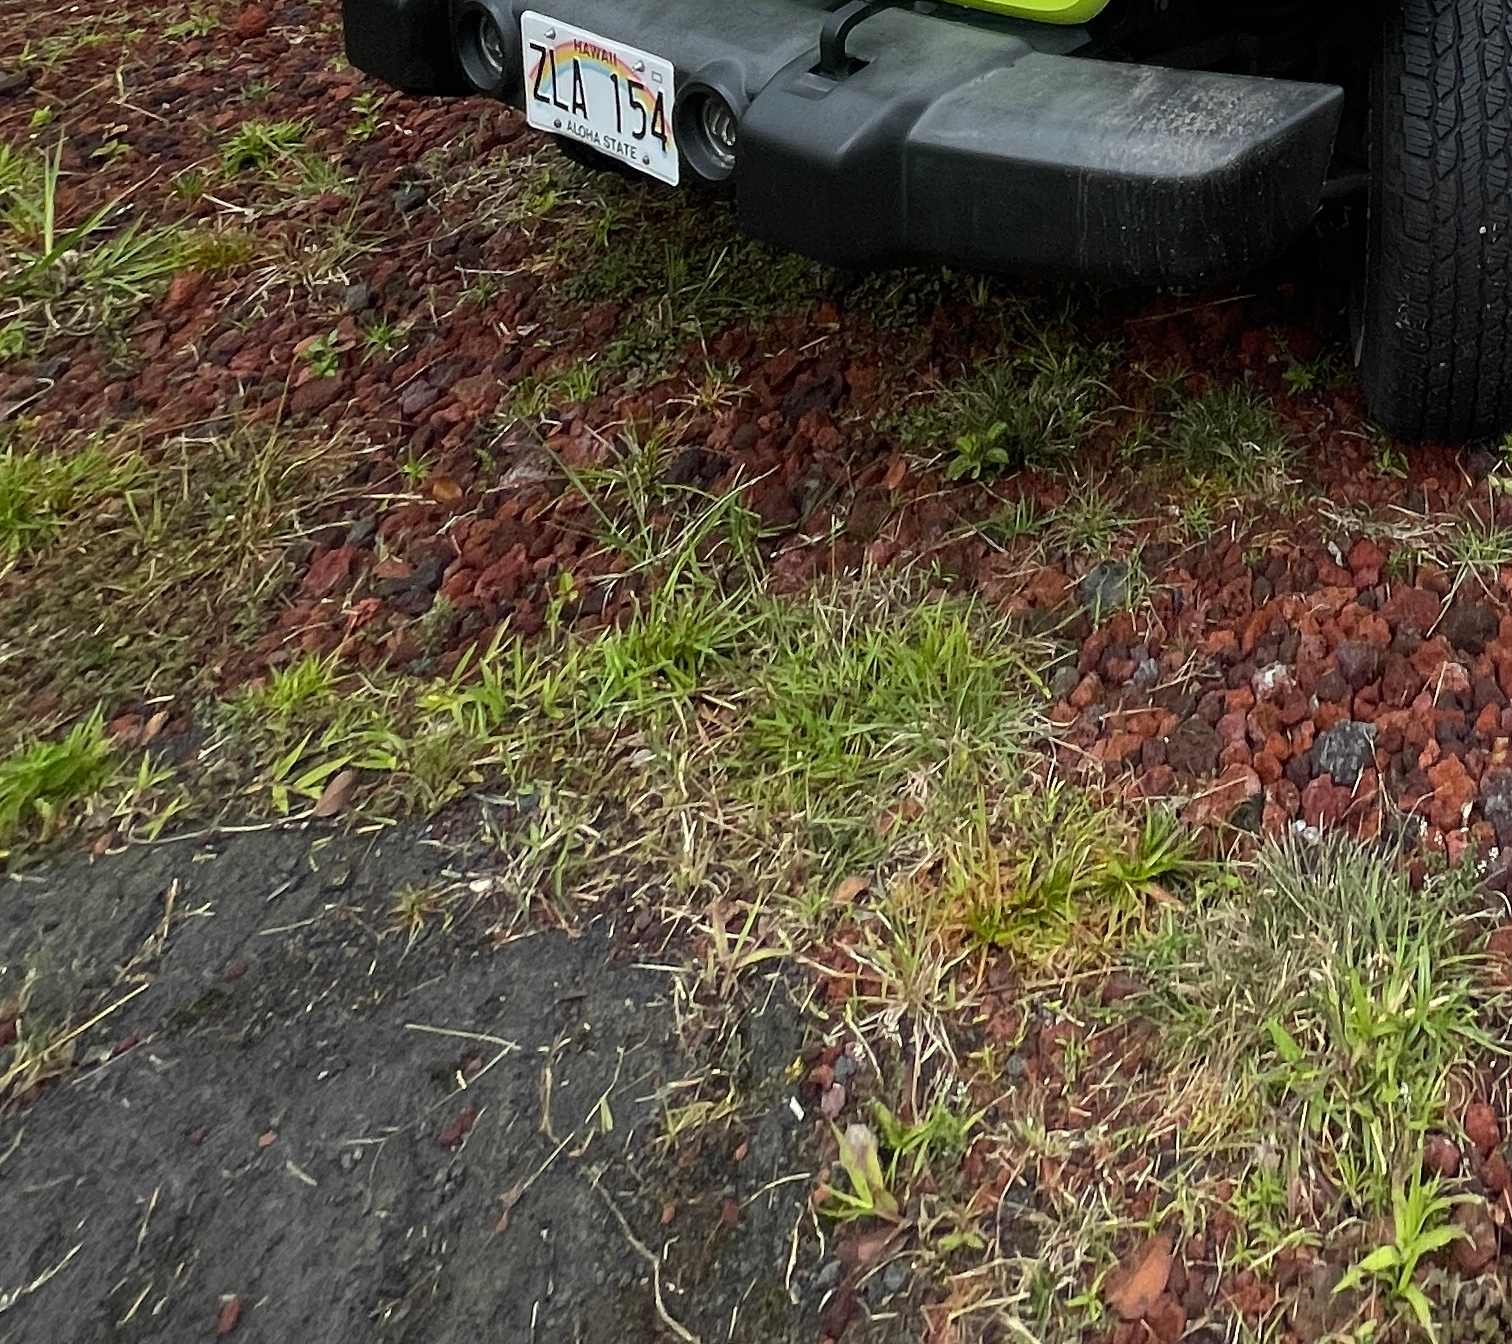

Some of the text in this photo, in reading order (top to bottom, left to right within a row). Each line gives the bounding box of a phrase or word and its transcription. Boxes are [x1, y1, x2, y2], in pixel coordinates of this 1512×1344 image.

[573, 38, 617, 67] HAWAII
[529, 42, 667, 153] ZLA 154
[566, 119, 637, 160] ALOHA STATE
